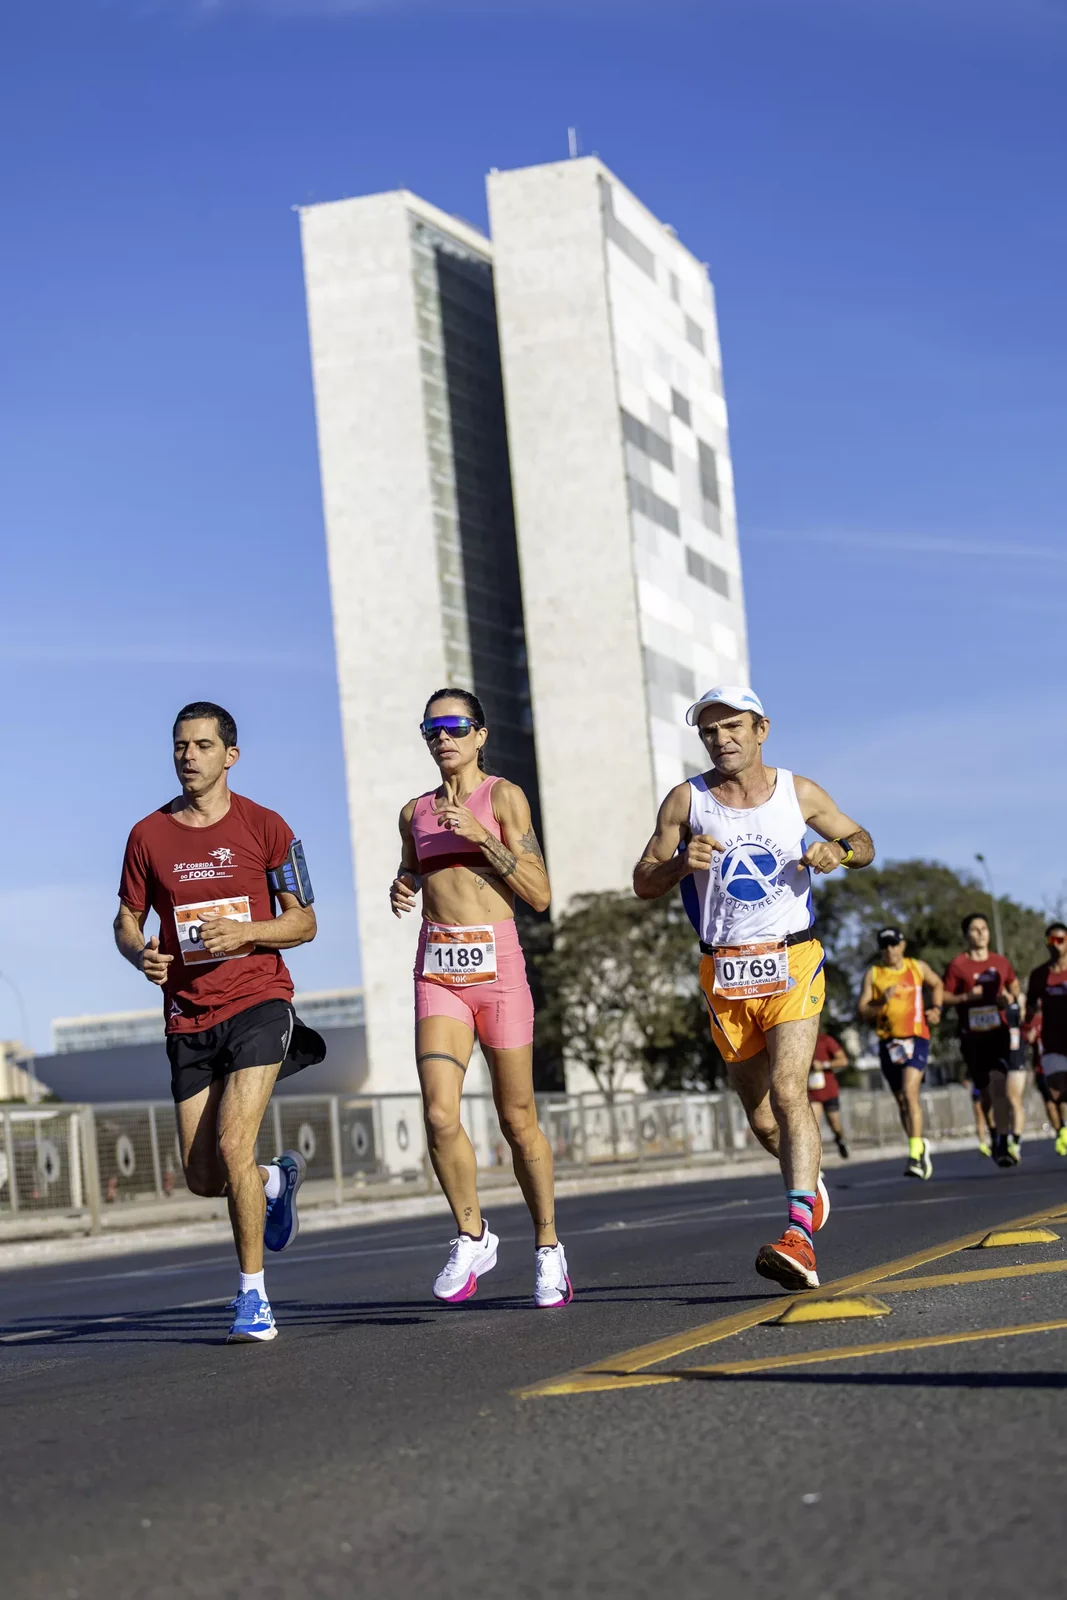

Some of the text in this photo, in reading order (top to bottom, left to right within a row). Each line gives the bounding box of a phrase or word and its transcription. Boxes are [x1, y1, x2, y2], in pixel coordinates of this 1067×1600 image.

[186, 861, 214, 869] CORRIDA
[189, 870, 215, 879] FOGO
[434, 947, 484, 967] 1189
[723, 958, 777, 981] 0769
[451, 975, 467, 983] 10K
[723, 977, 780, 988] HENRIQUE CARVALHO
[743, 986, 759, 995] 10K
